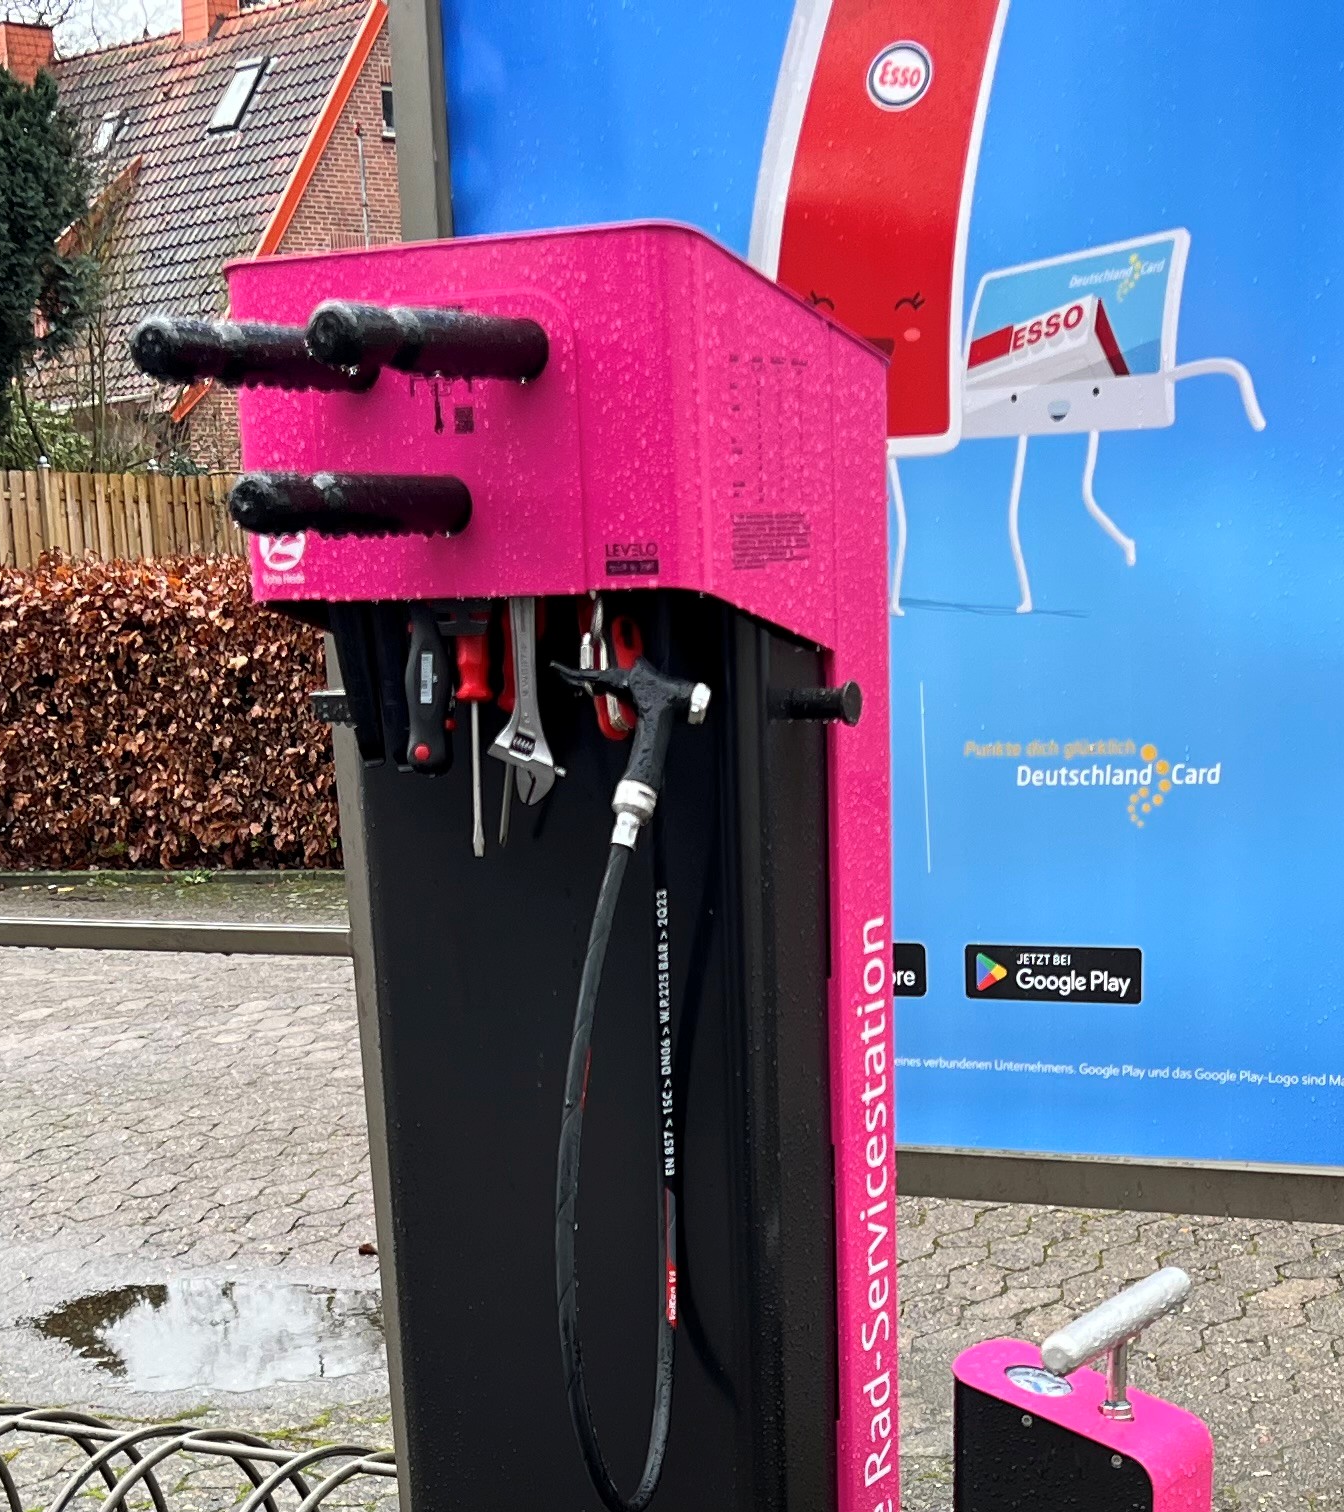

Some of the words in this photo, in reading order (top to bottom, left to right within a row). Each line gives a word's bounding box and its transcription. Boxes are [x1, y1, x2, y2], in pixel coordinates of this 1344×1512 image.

[879, 59, 921, 87] Esso
[1068, 264, 1134, 289] Deutschland
[1140, 256, 1166, 275] Card
[1012, 305, 1083, 351] ESSO
[1027, 740, 1059, 757] dich
[1016, 764, 1153, 787] Deutschland
[1171, 762, 1222, 785] Card
[657, 942, 669, 971] BAR
[1016, 953, 1051, 966] JETZT
[1052, 954, 1071, 966] BEI
[1015, 968, 1087, 996] Google
[1090, 970, 1131, 997] Play
[660, 1038, 672, 1076] DN06
[923, 1056, 993, 1071] verbundenen
[994, 1059, 1076, 1074] Unternehmens.
[1079, 1062, 1120, 1078] Google
[1122, 1064, 1145, 1080] Play
[1148, 1065, 1169, 1079] und
[1172, 1066, 1191, 1080] das
[1195, 1067, 1237, 1085] Google
[1239, 1070, 1299, 1087] Play-Logo
[1302, 1073, 1326, 1086] sind
[663, 1130, 675, 1155] 857
[664, 1157, 675, 1177] EN
[859, 916, 893, 1488] Rad-Servicestation
